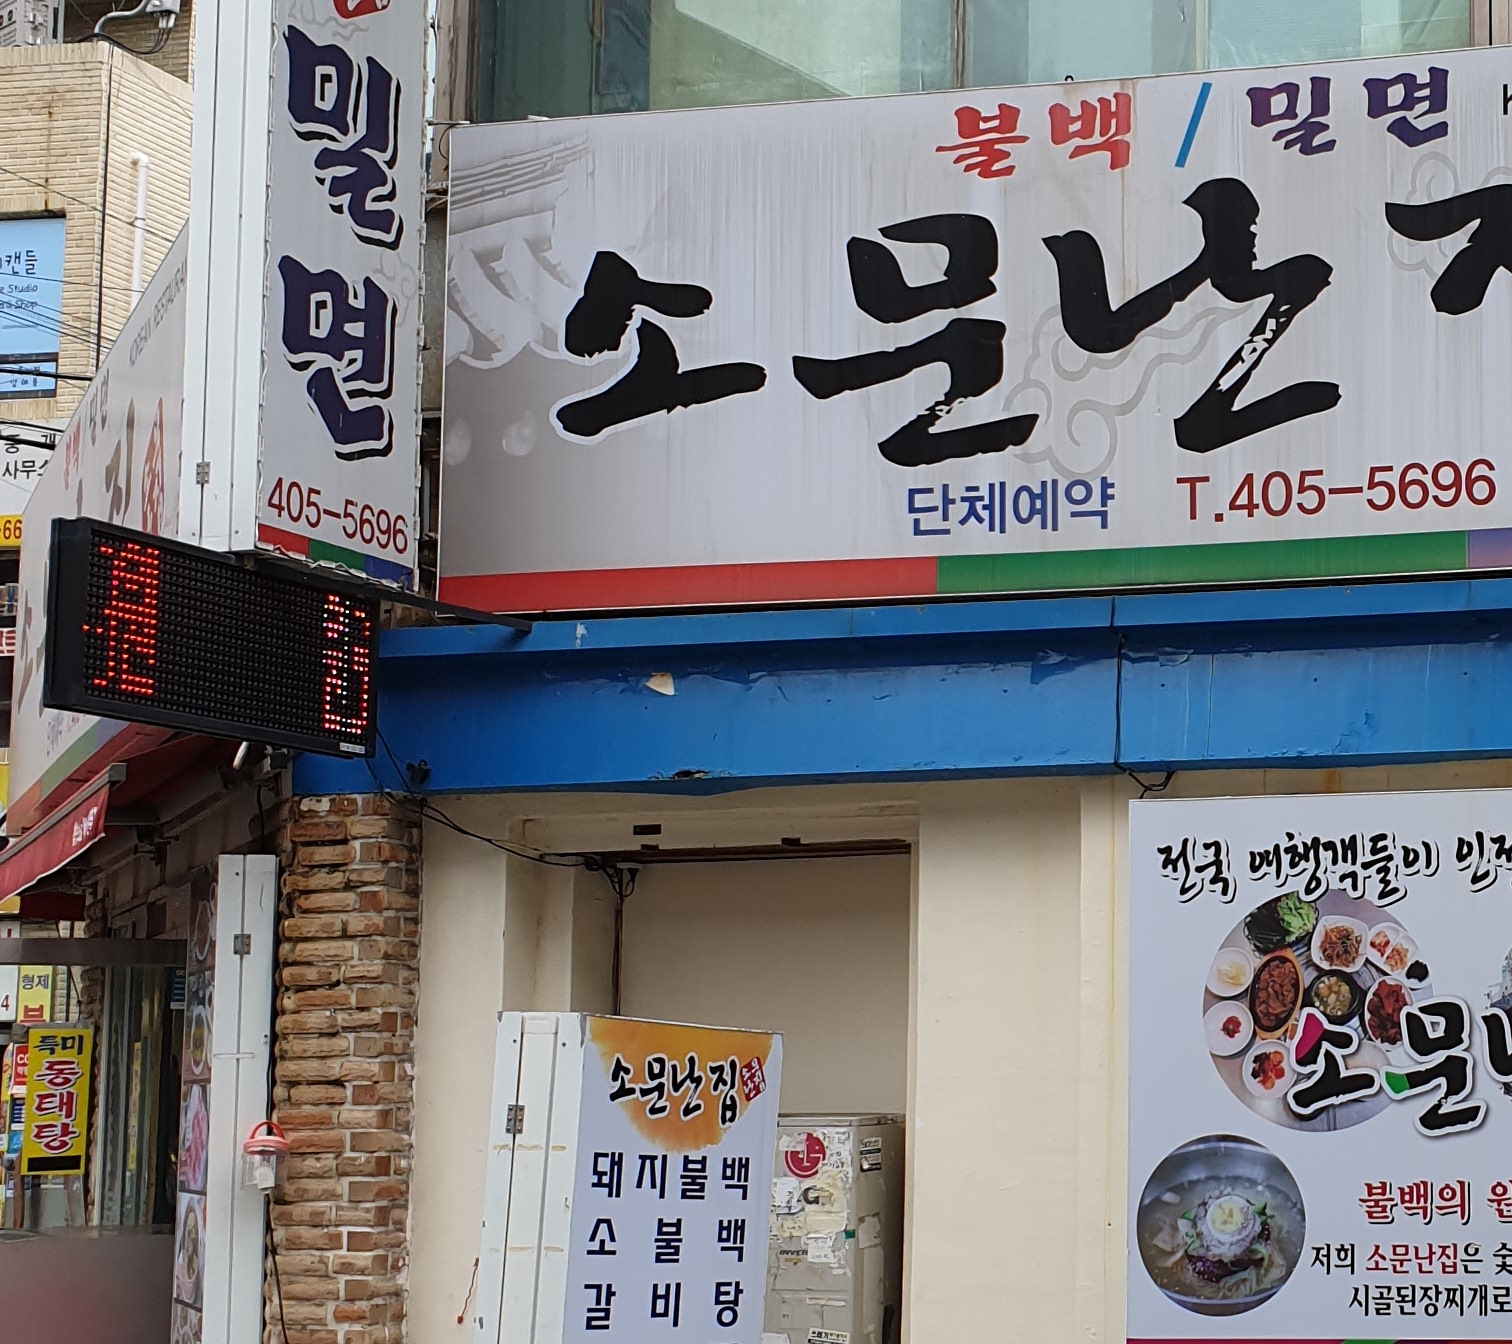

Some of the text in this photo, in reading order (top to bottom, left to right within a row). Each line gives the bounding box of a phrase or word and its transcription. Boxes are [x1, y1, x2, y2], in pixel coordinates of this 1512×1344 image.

[934, 90, 1133, 181] 불백
[1249, 65, 1451, 156] 밀면
[279, 24, 403, 460] 밀면
[267, 475, 409, 556] 405-5696
[905, 474, 1116, 537] 단체예약
[1176, 457, 1497, 525] T.405-5696
[1157, 834, 1233, 903] 전국
[1249, 830, 1439, 905] 여행객들이
[32, 1059, 82, 1155] 동태탕
[609, 1056, 739, 1125] 소문난집
[591, 1151, 751, 1201] 돼지불백
[1357, 1179, 1471, 1224] 불백의
[1310, 1242, 1357, 1275] 저희
[1365, 1242, 1483, 1275] 소문난집은
[584, 1280, 744, 1332] 갈비탕
